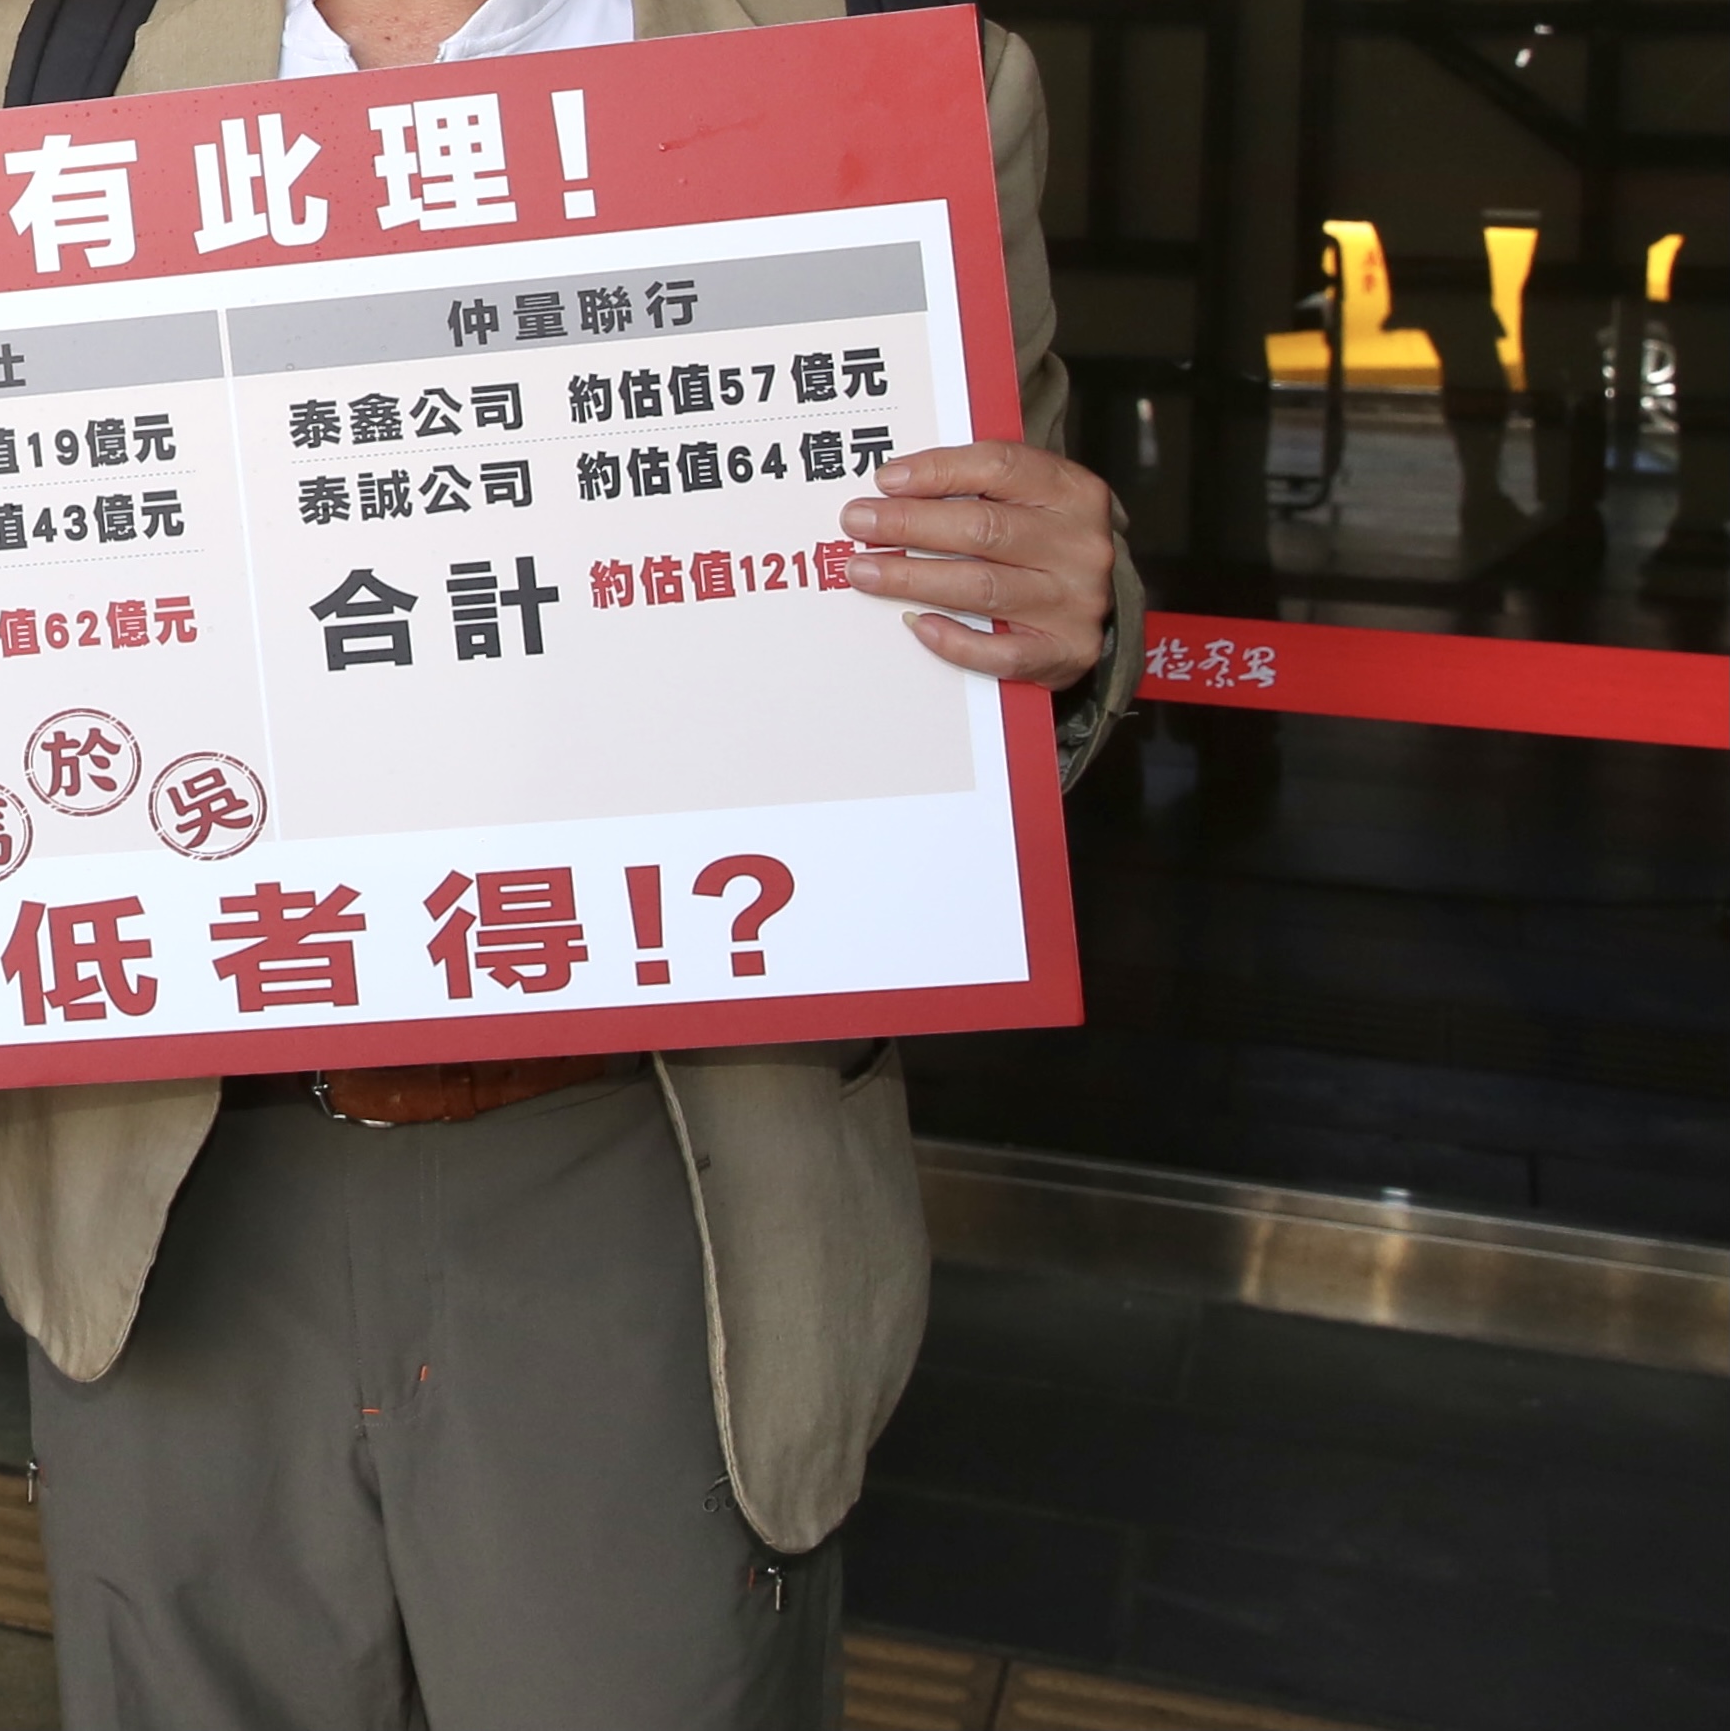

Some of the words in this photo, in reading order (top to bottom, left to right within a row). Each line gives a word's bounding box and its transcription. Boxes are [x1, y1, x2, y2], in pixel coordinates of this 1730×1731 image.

[446, 279, 700, 348] 仲量聯行
[288, 381, 526, 450] 泰鑫公司
[567, 346, 890, 424] 約估值57億元
[297, 459, 535, 527] 泰誠公司
[575, 425, 894, 502] 約估值64億元
[308, 555, 561, 672] 合計
[589, 539, 907, 611] 約估值121億
[40, 726, 121, 800] 於
[167, 766, 255, 851] 吳
